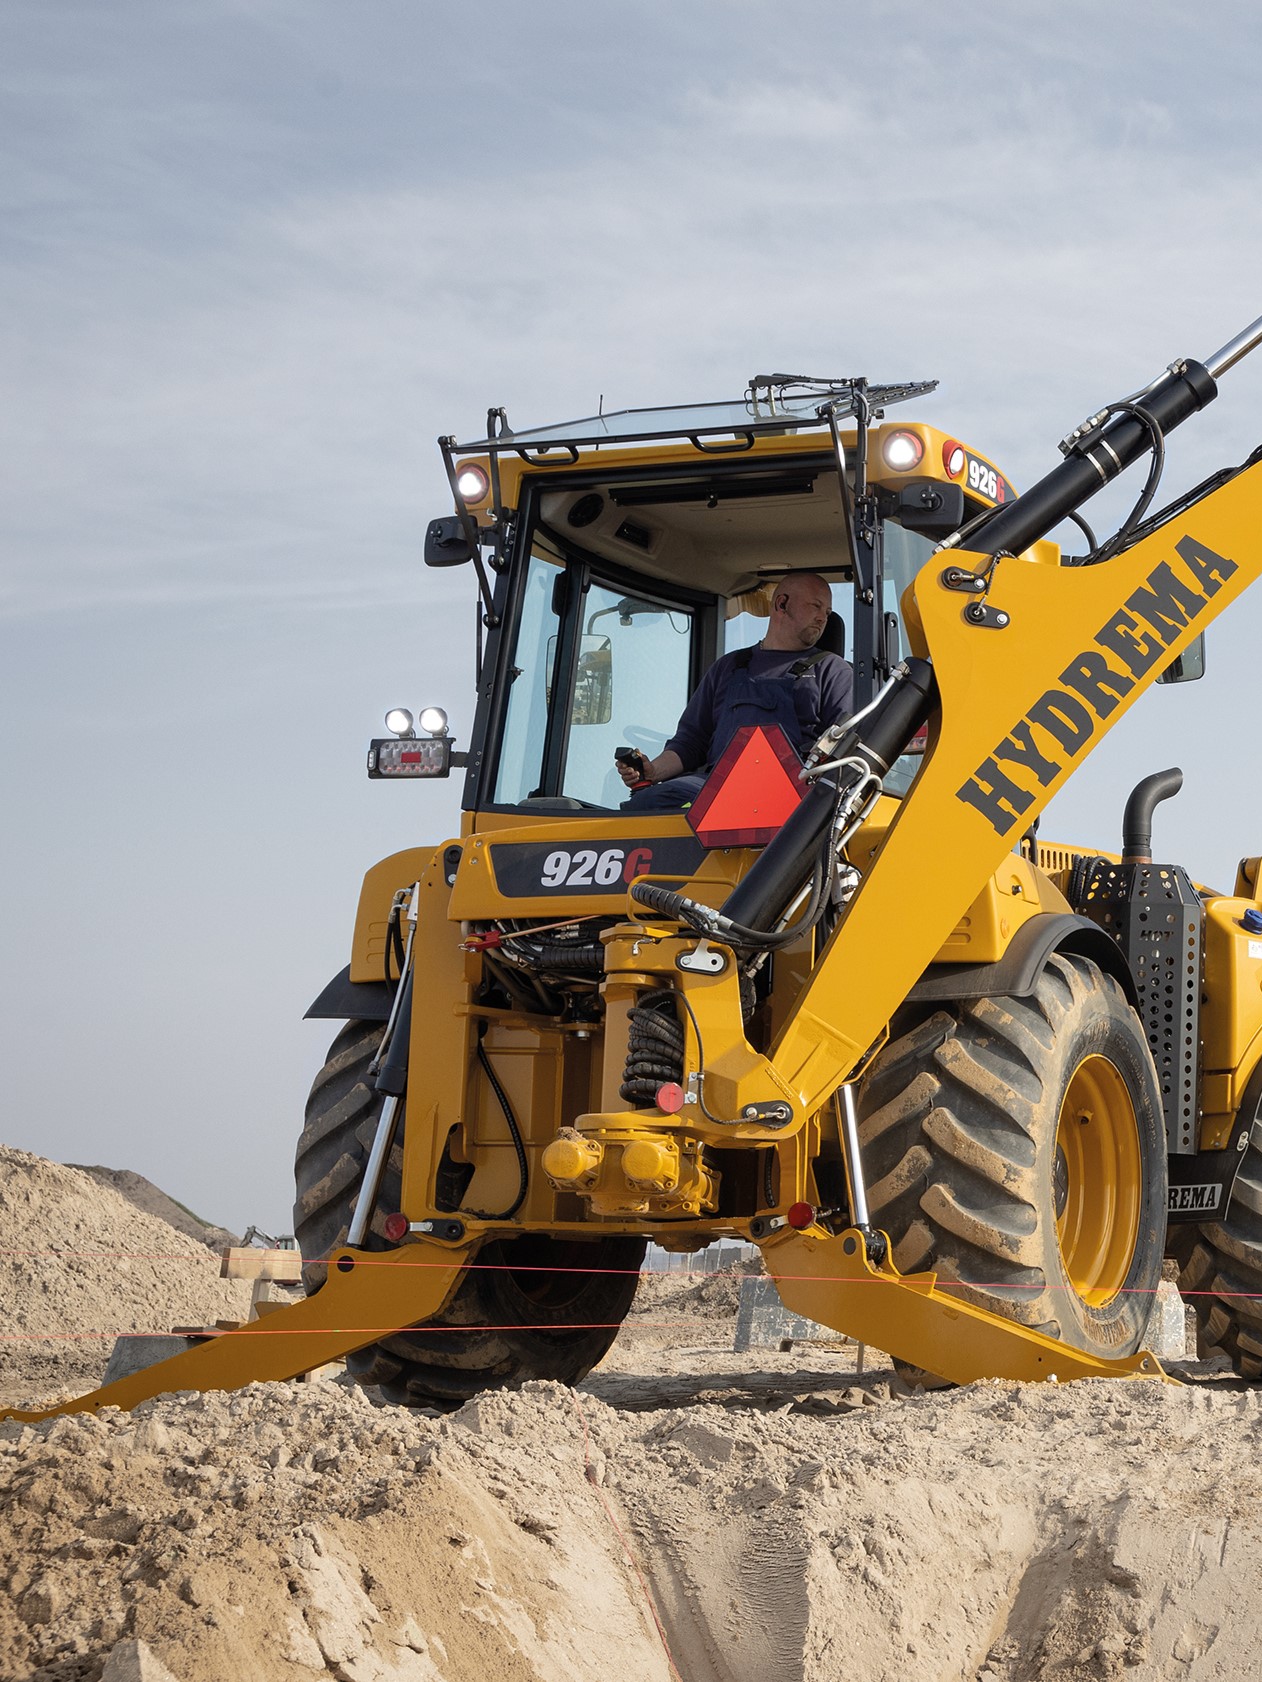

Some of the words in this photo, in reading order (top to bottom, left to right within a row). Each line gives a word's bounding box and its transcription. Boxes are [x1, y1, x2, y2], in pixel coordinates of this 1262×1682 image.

[955, 534, 1239, 837] HYDREMA
[540, 848, 653, 887] 926G
[1168, 1186, 1216, 1209] REMA
